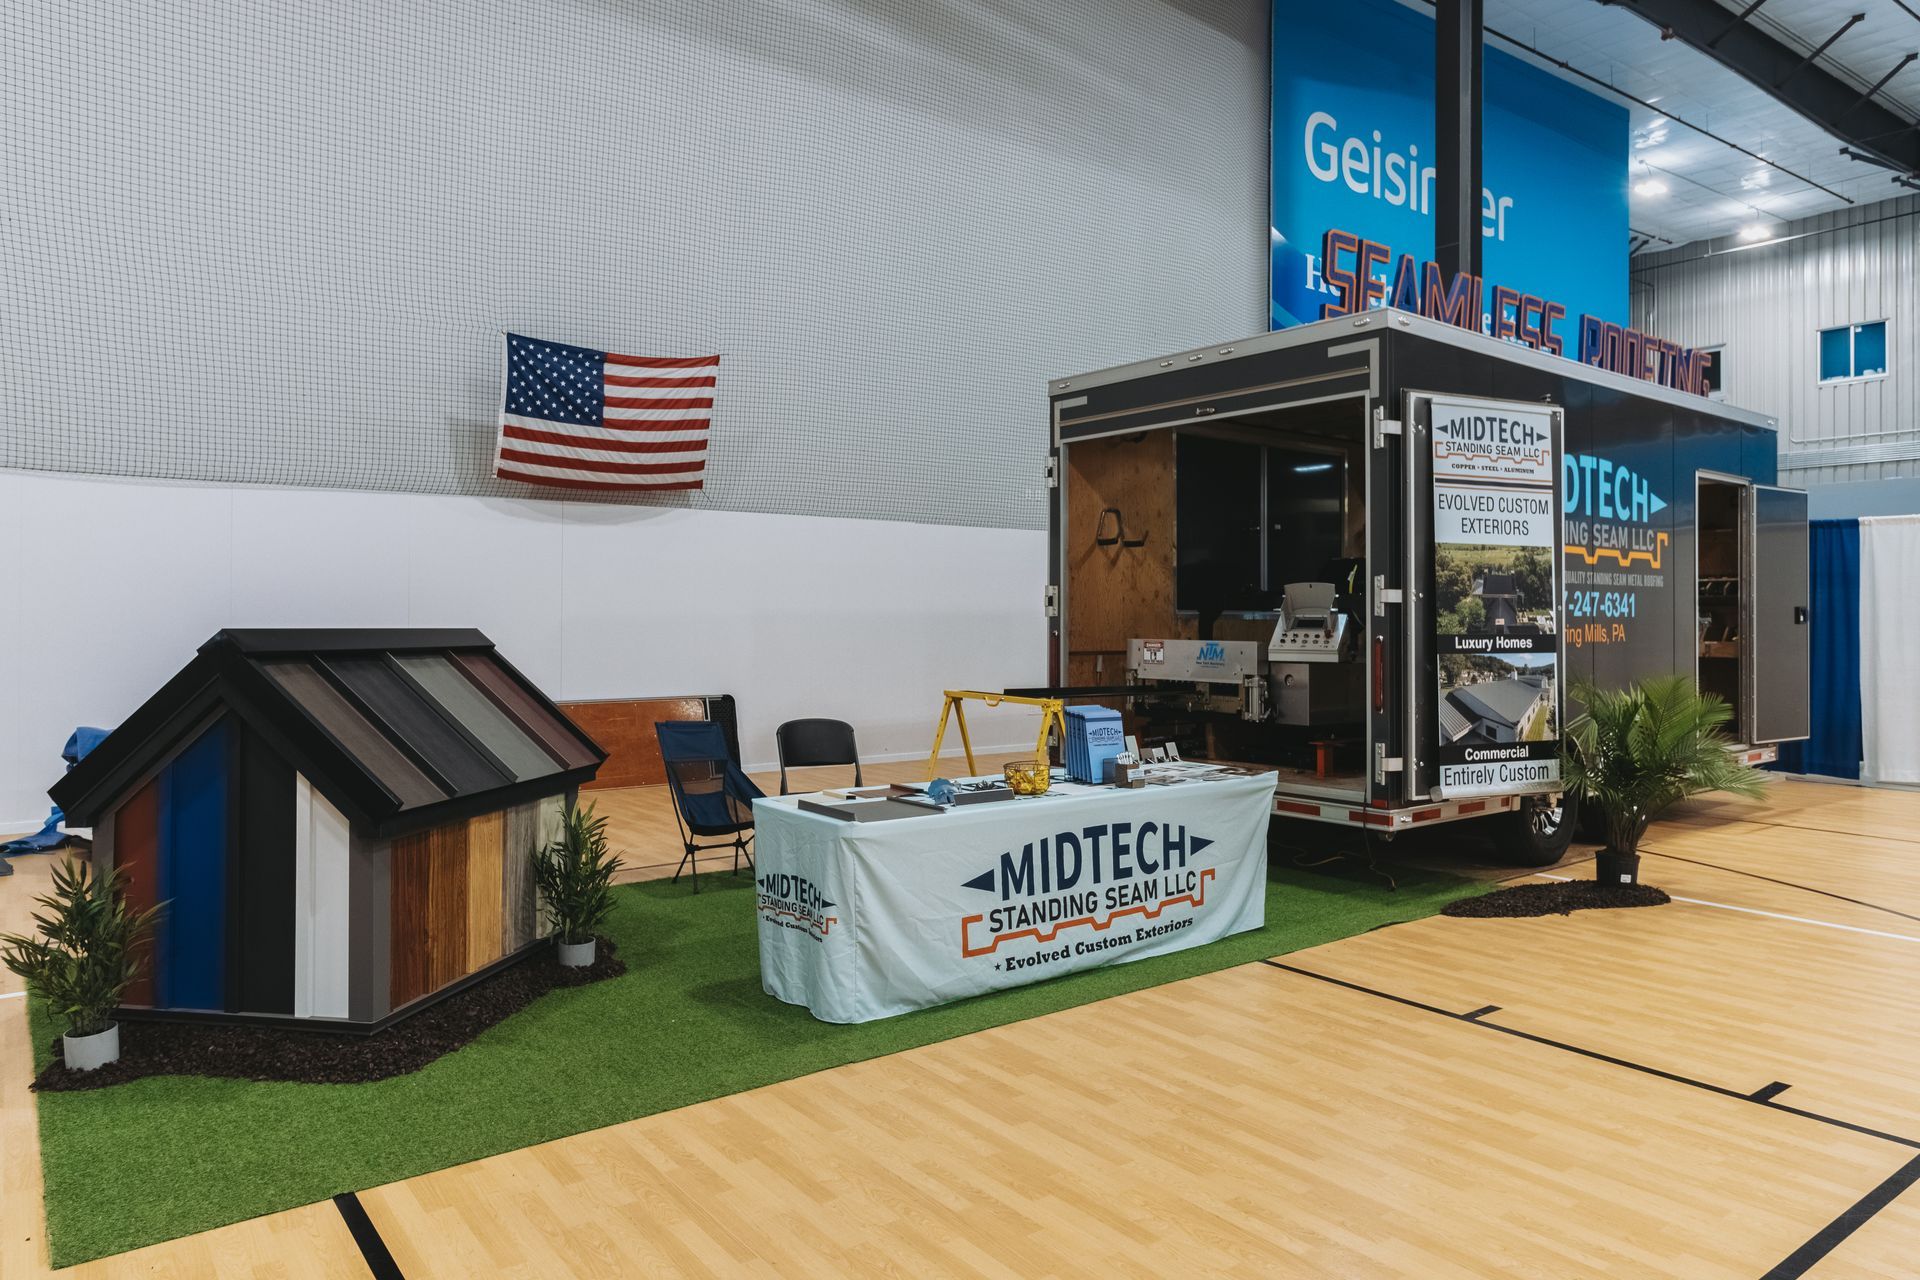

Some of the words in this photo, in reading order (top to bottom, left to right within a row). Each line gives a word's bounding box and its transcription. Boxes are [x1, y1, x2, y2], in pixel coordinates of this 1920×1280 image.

[1304, 111, 1513, 241] Geisiner
[1450, 416, 1534, 446] MIDTECH
[1445, 441, 1493, 454] STANDING
[1496, 445, 1520, 456] SEAM
[1523, 448, 1540, 458] LLC
[1564, 453, 1648, 523] DTECH
[1438, 494, 1495, 512] EVOLVED
[1498, 497, 1549, 515] CUSTOM
[1461, 517, 1529, 536] EXTERIORS
[1593, 524, 1628, 549] SEAM
[1632, 528, 1654, 551] LLC
[1565, 590, 1635, 617] -247-6341
[1455, 636, 1493, 651] Luxury
[1496, 636, 1533, 648] Homes
[1585, 624, 1610, 645] Mills,
[1612, 624, 1626, 642] PA
[1092, 727, 1118, 736] MIDTECH
[1465, 745, 1529, 761] Commercial
[1444, 765, 1495, 786] Entirely
[1500, 764, 1549, 782] Custom
[1000, 821, 1186, 901] MIDTECH
[766, 873, 822, 911] MIDTECH
[989, 891, 1098, 933] STANDING
[1105, 878, 1158, 910] SEAM
[1164, 871, 1197, 897] LLC
[1006, 946, 1071, 972] Evolved
[1075, 935, 1133, 955] Custom
[1135, 916, 1194, 942] Exteriors
